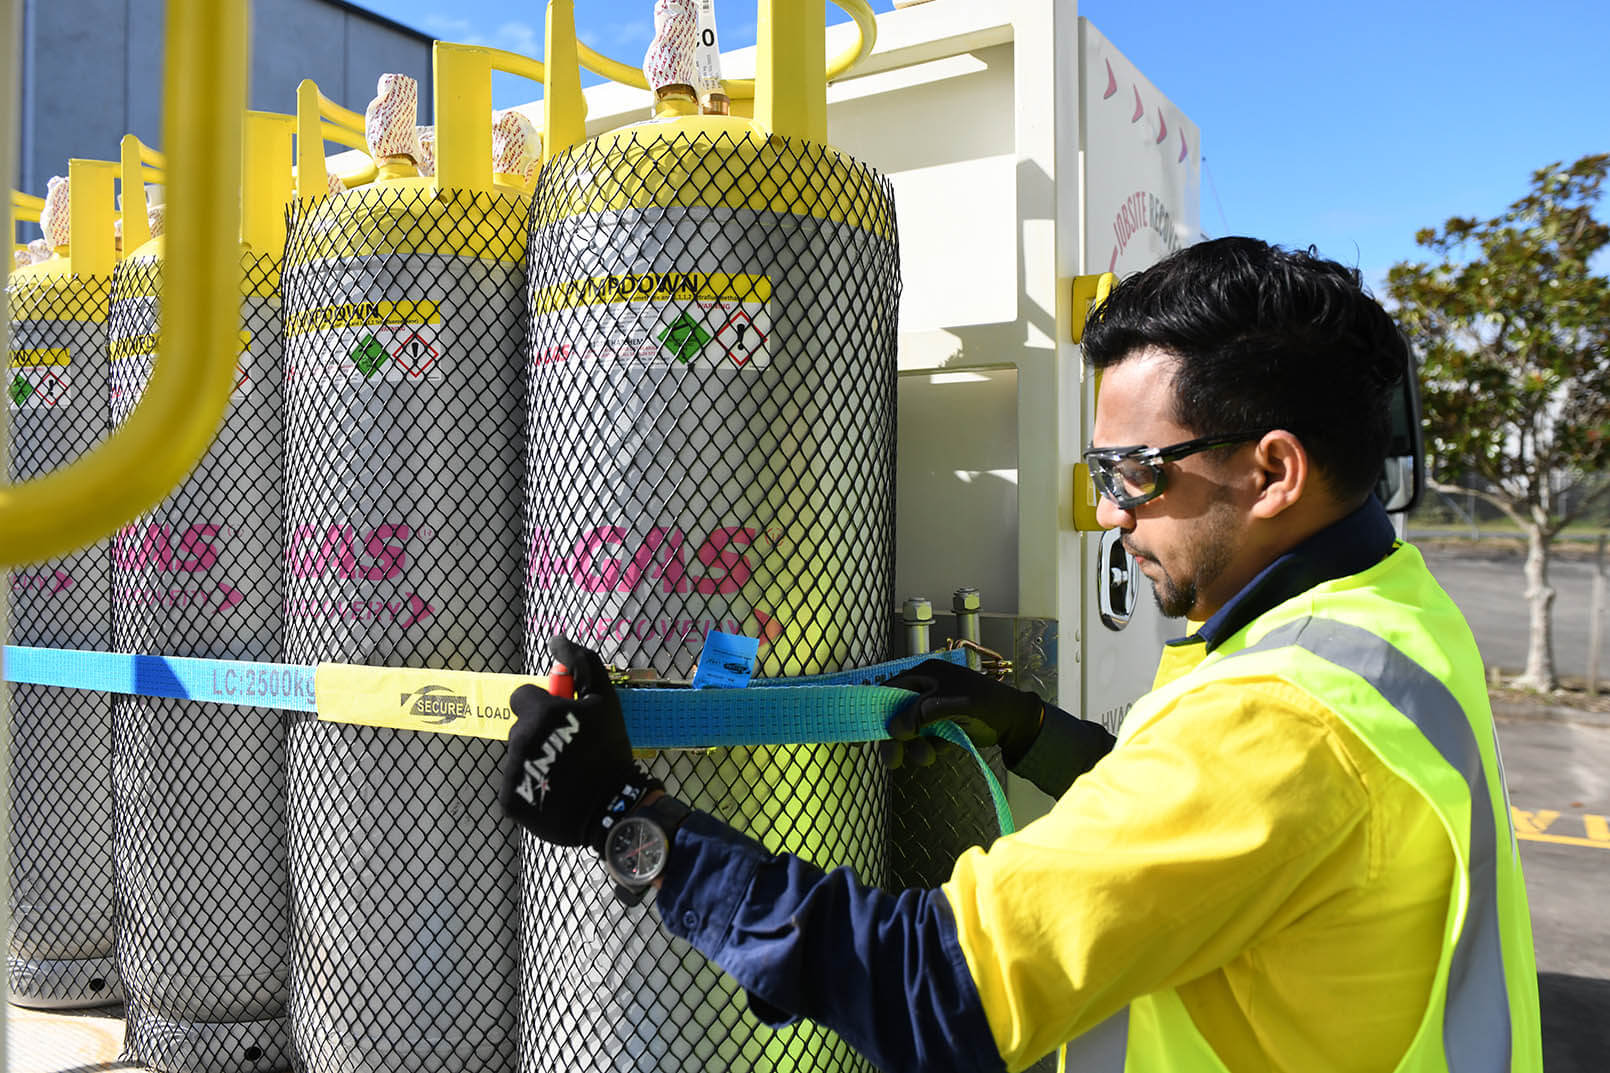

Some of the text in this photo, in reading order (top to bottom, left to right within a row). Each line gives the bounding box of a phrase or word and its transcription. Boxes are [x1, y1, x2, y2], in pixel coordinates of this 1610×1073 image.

[1113, 191, 1182, 256] JOBSITE RECOVE
[213, 668, 316, 704] LC:2500kg
[417, 698, 465, 717] SECURE
[477, 706, 512, 721] LOAD
